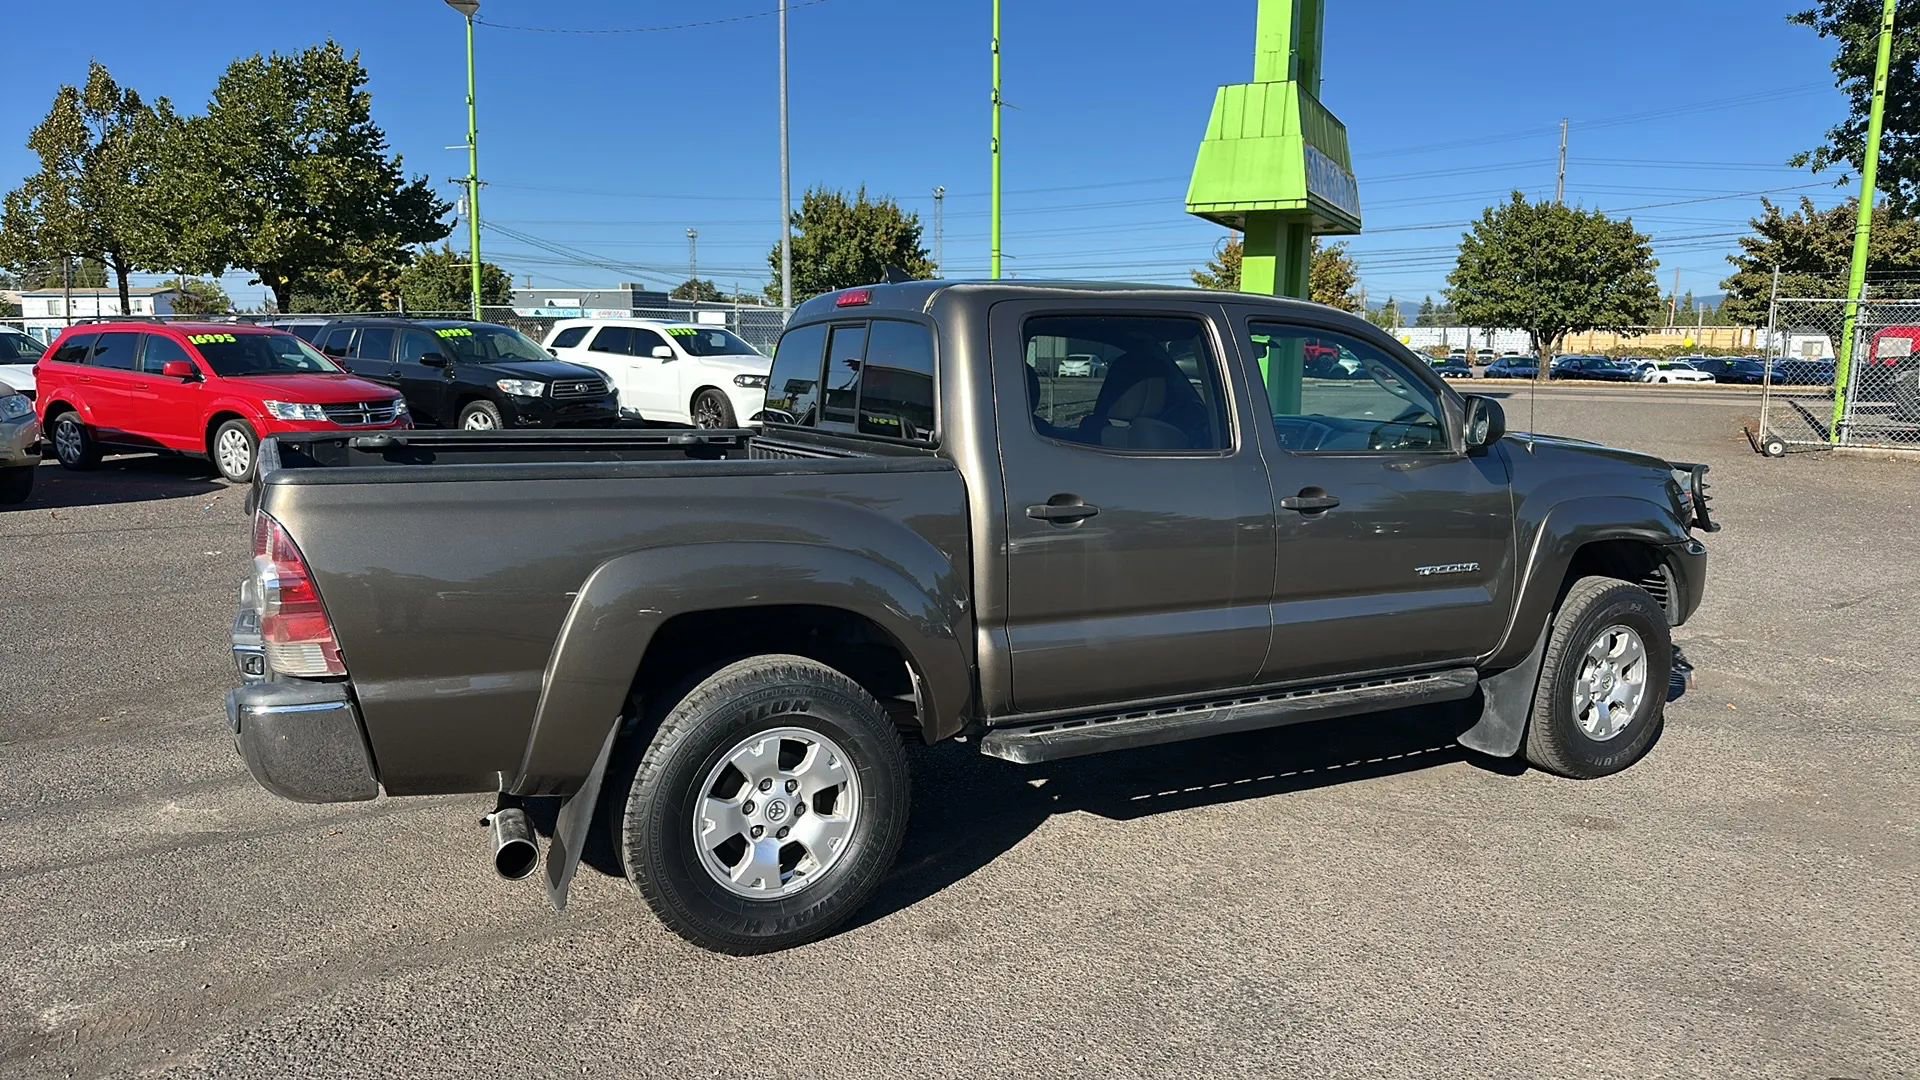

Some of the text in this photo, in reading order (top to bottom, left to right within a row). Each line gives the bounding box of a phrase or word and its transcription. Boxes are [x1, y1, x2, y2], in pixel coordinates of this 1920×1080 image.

[187, 333, 237, 345] 16995
[435, 328, 473, 338] 10995
[1414, 562, 1481, 576] TACOMA
